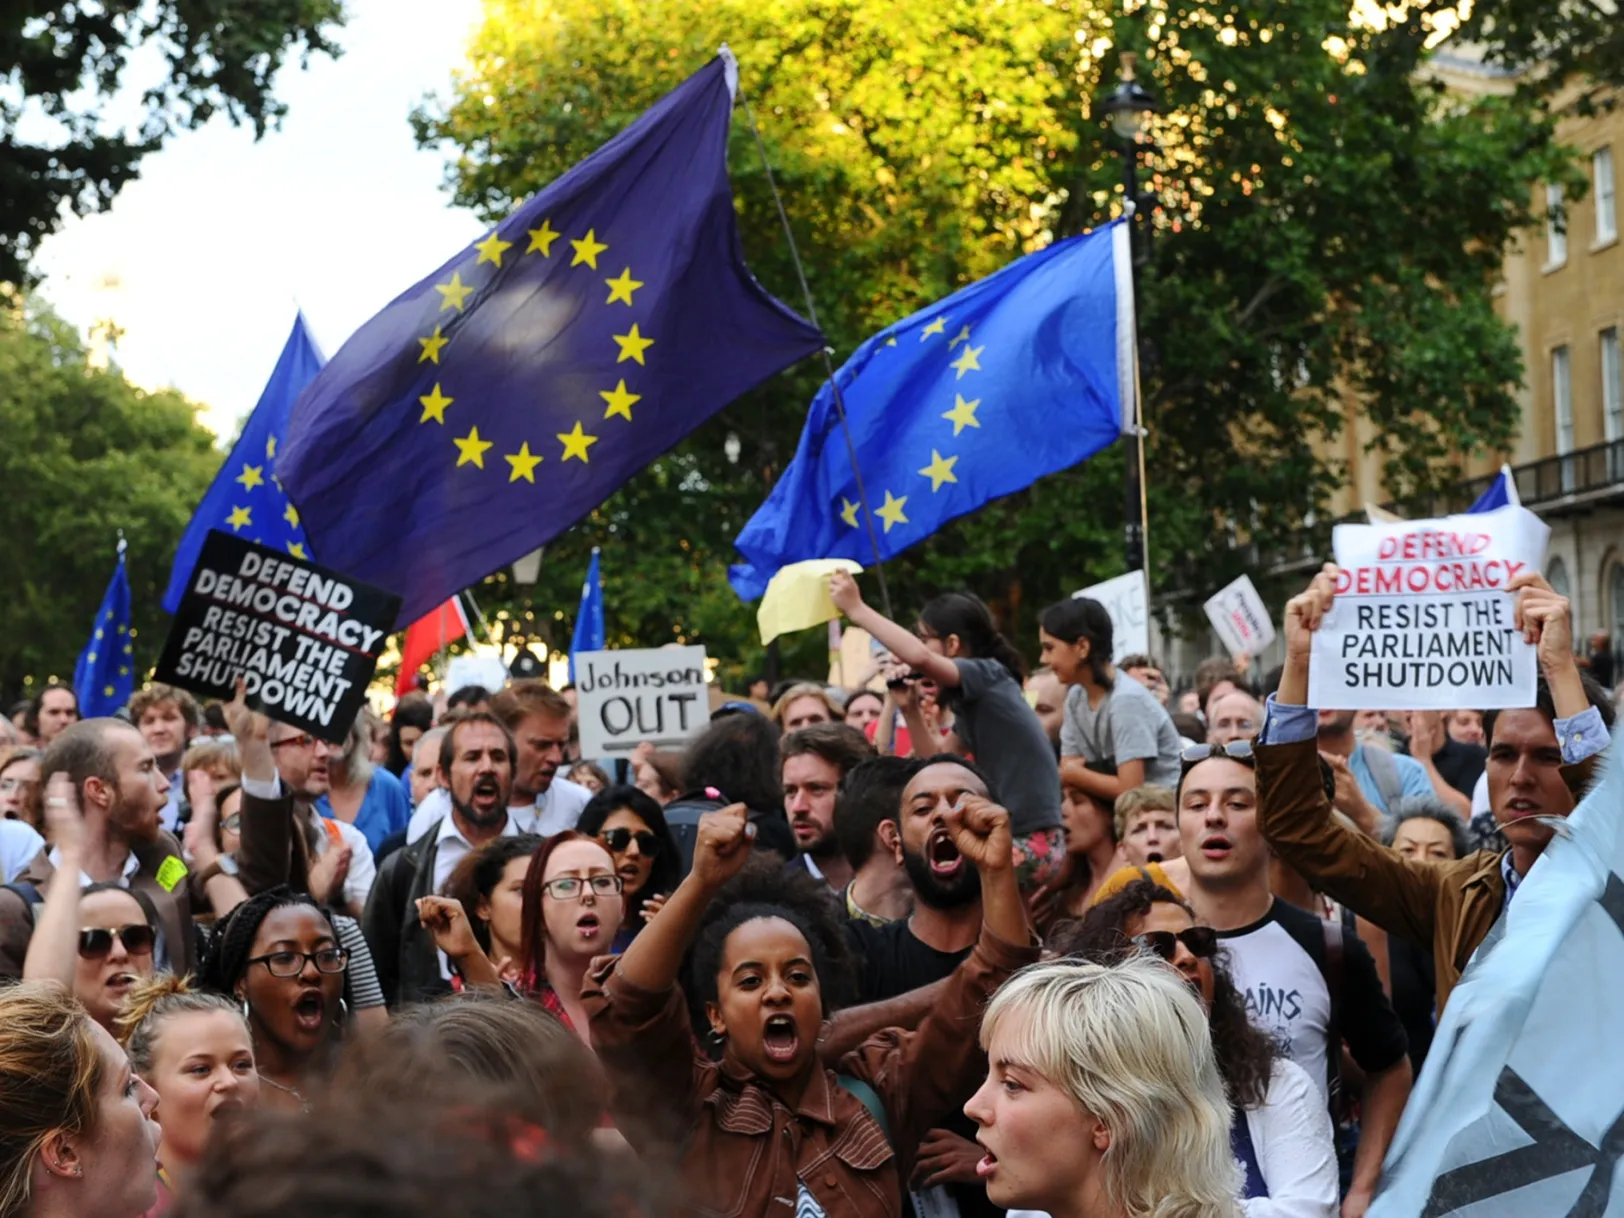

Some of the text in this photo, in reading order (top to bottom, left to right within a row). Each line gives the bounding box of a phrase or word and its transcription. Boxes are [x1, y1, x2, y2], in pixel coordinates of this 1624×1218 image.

[1378, 532, 1492, 560] DEFEND
[239, 552, 354, 611] DEFEND
[1333, 560, 1526, 595] DEMOCRACY
[194, 568, 384, 653] DEMOCRACY
[1357, 599, 1503, 630] RESIST THE
[203, 606, 349, 676] RESIST THE
[1341, 629, 1514, 658] PARLIAMENT
[182, 627, 352, 703] PARLIAMENT
[581, 661, 702, 693] Johnson
[1344, 659, 1513, 687] SHUTDOWN
[176, 652, 336, 727] SHUTDOWN
[600, 693, 697, 736] OUT
